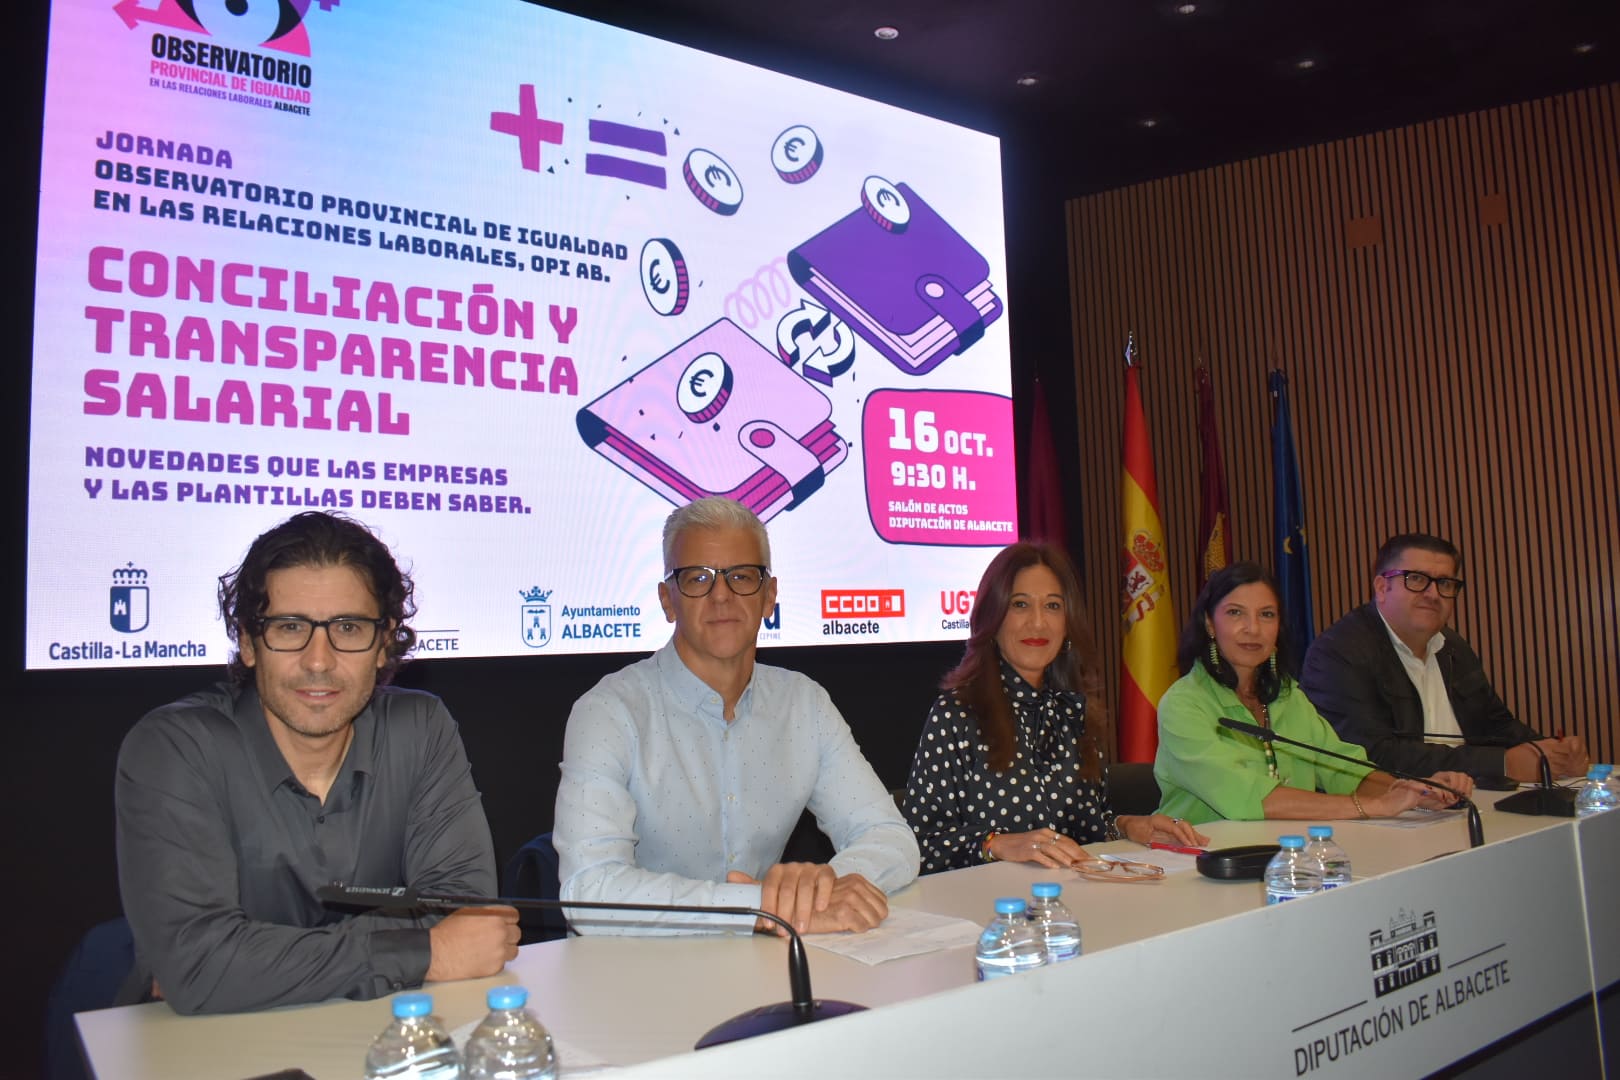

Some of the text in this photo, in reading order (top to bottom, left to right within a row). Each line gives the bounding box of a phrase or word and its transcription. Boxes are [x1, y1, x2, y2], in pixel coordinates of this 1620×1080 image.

[151, 33, 312, 88] OBSERVATORIO
[149, 77, 311, 116] EN LAS RELACIONES LABORALES ALBACETE
[150, 60, 311, 104] PROVINCIAL DE IGUALDAD
[96, 130, 233, 169] JORNADA
[95, 159, 629, 261] OBSERVATORIO PROVINCIAL DE IGUALDAD
[93, 189, 611, 283] EN LAS RELACIONES LABORALES, OPI AB.
[87, 246, 579, 344] CONCILIACIÓN Y
[84, 306, 579, 396] TRANSPARENCIA
[83, 368, 410, 436] SALARIAL
[888, 407, 994, 457] 16 OCT.
[85, 446, 509, 487] NOVEDADES QUE LAS EMPRESAS
[890, 461, 977, 491] 9:30 H.
[83, 478, 532, 515] Y LAS PLANTILLAS DEBEN SABER.
[888, 499, 968, 515] SALÓN DE ACTOS
[889, 516, 1013, 532] DIPUTACIÓN DE ALBACETE
[561, 604, 641, 619] Ayuntamiento
[825, 595, 880, 613] CCOO
[562, 622, 641, 640] ALBACETE
[823, 620, 880, 635] albacete
[144, 641, 207, 659] Mancha
[1294, 960, 1511, 1077] DIPUTACIÓN DE ALBACETE
